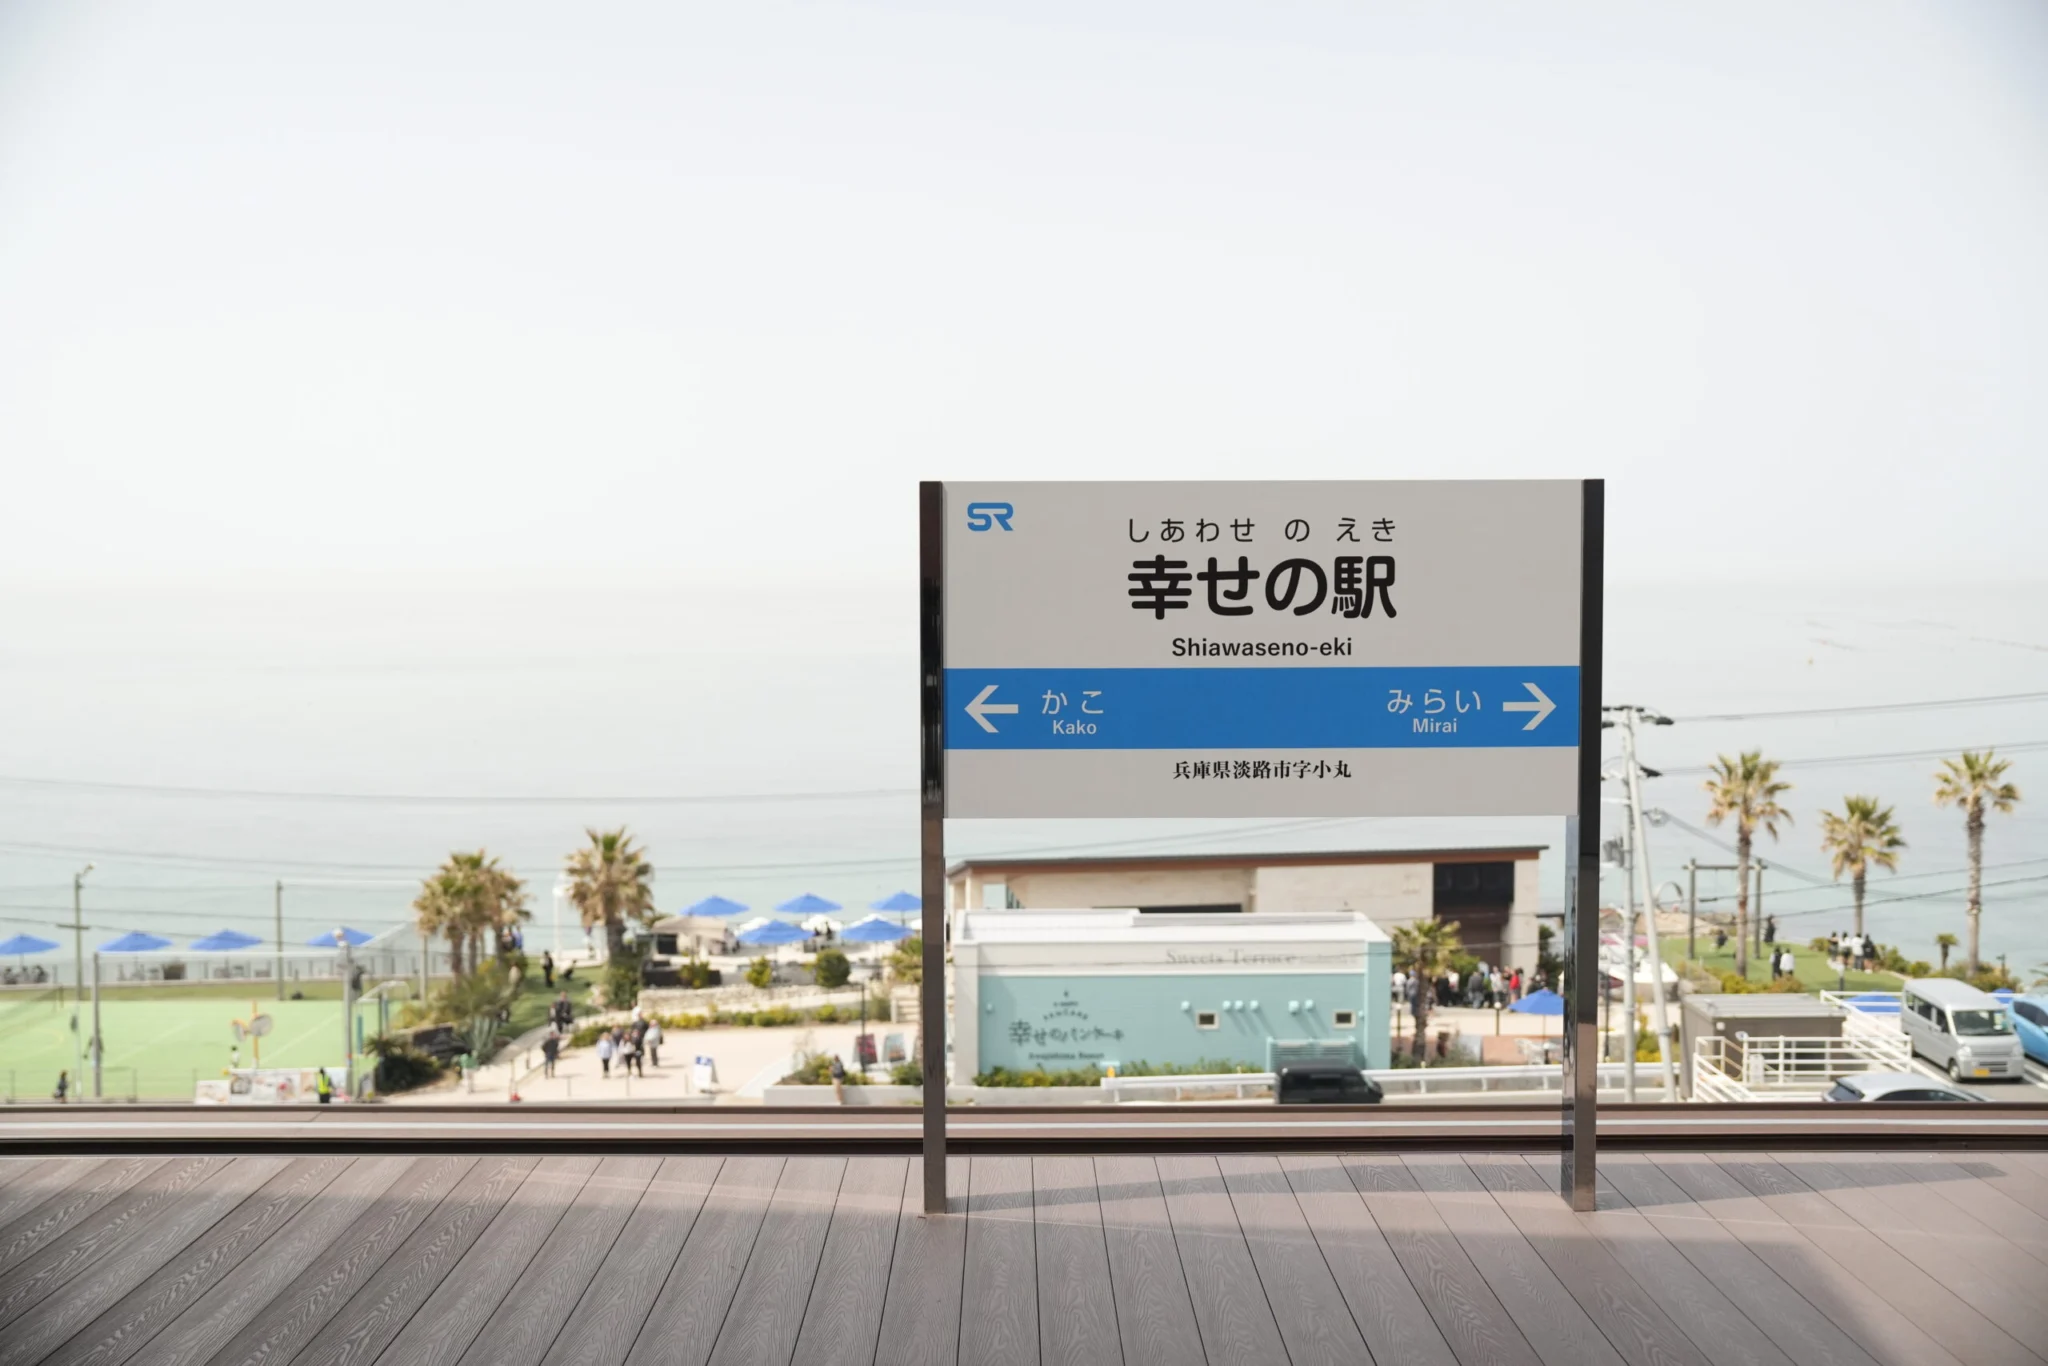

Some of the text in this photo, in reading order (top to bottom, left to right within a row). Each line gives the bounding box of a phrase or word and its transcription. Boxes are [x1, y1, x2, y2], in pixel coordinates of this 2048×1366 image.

[967, 502, 1014, 532] SR
[1129, 518, 1397, 543] しあわせ の えき
[1127, 553, 1398, 621] 幸せの駅
[1171, 637, 1352, 657] Shiawaseno-eki
[1041, 688, 1105, 715] かこ
[1386, 687, 1482, 714] みらい
[1053, 719, 1097, 735] Kako
[1412, 717, 1457, 733] Mirai
[1173, 760, 1352, 780] 兵庫県淡路市字小丸
